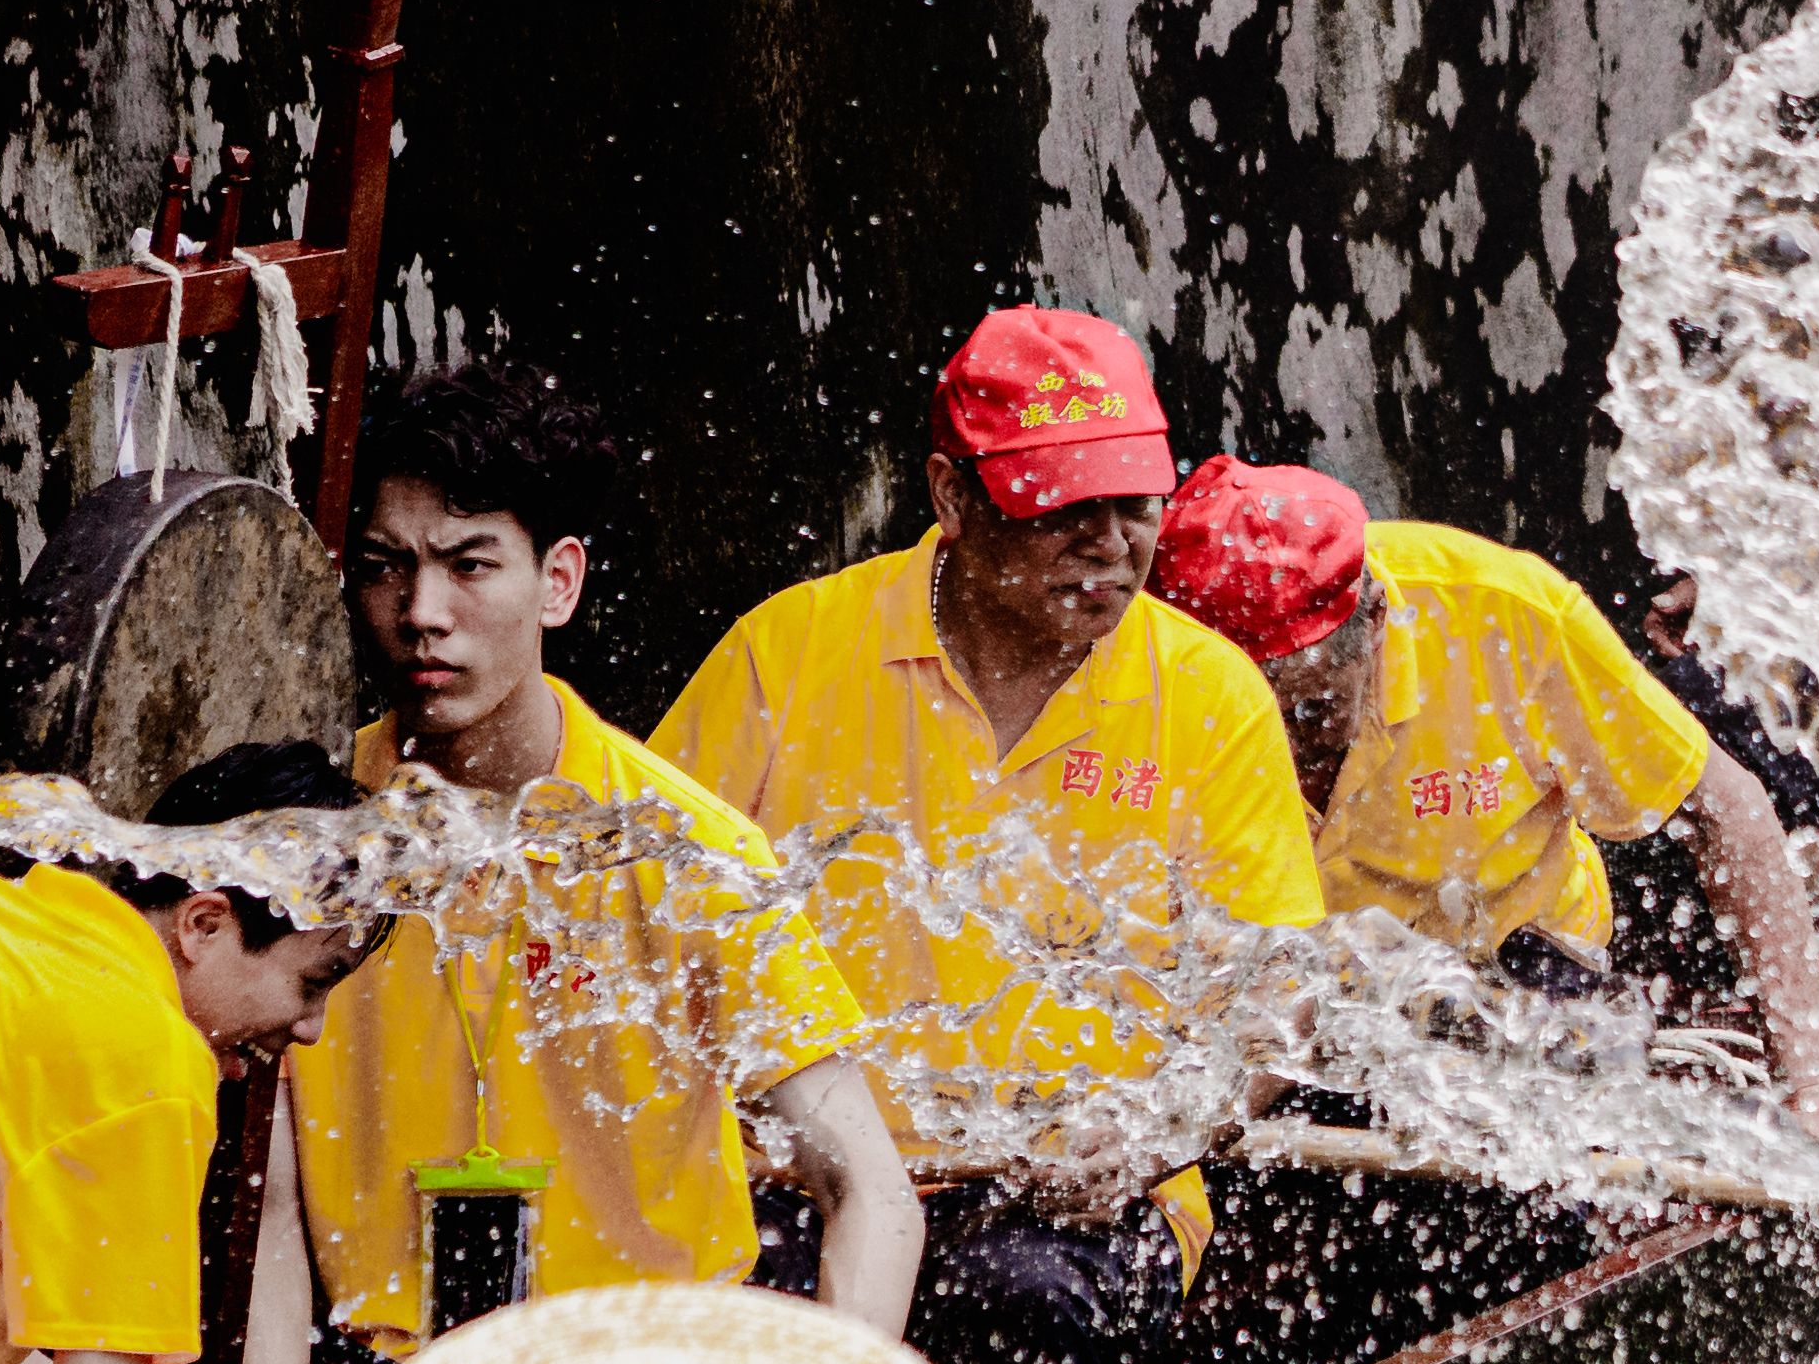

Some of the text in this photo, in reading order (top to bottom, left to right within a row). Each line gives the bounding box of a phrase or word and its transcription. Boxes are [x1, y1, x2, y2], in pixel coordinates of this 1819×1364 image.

[1019, 391, 1128, 430] 凝金坊
[1059, 748, 1164, 812] 西渚
[1408, 762, 1505, 821] 西渚
